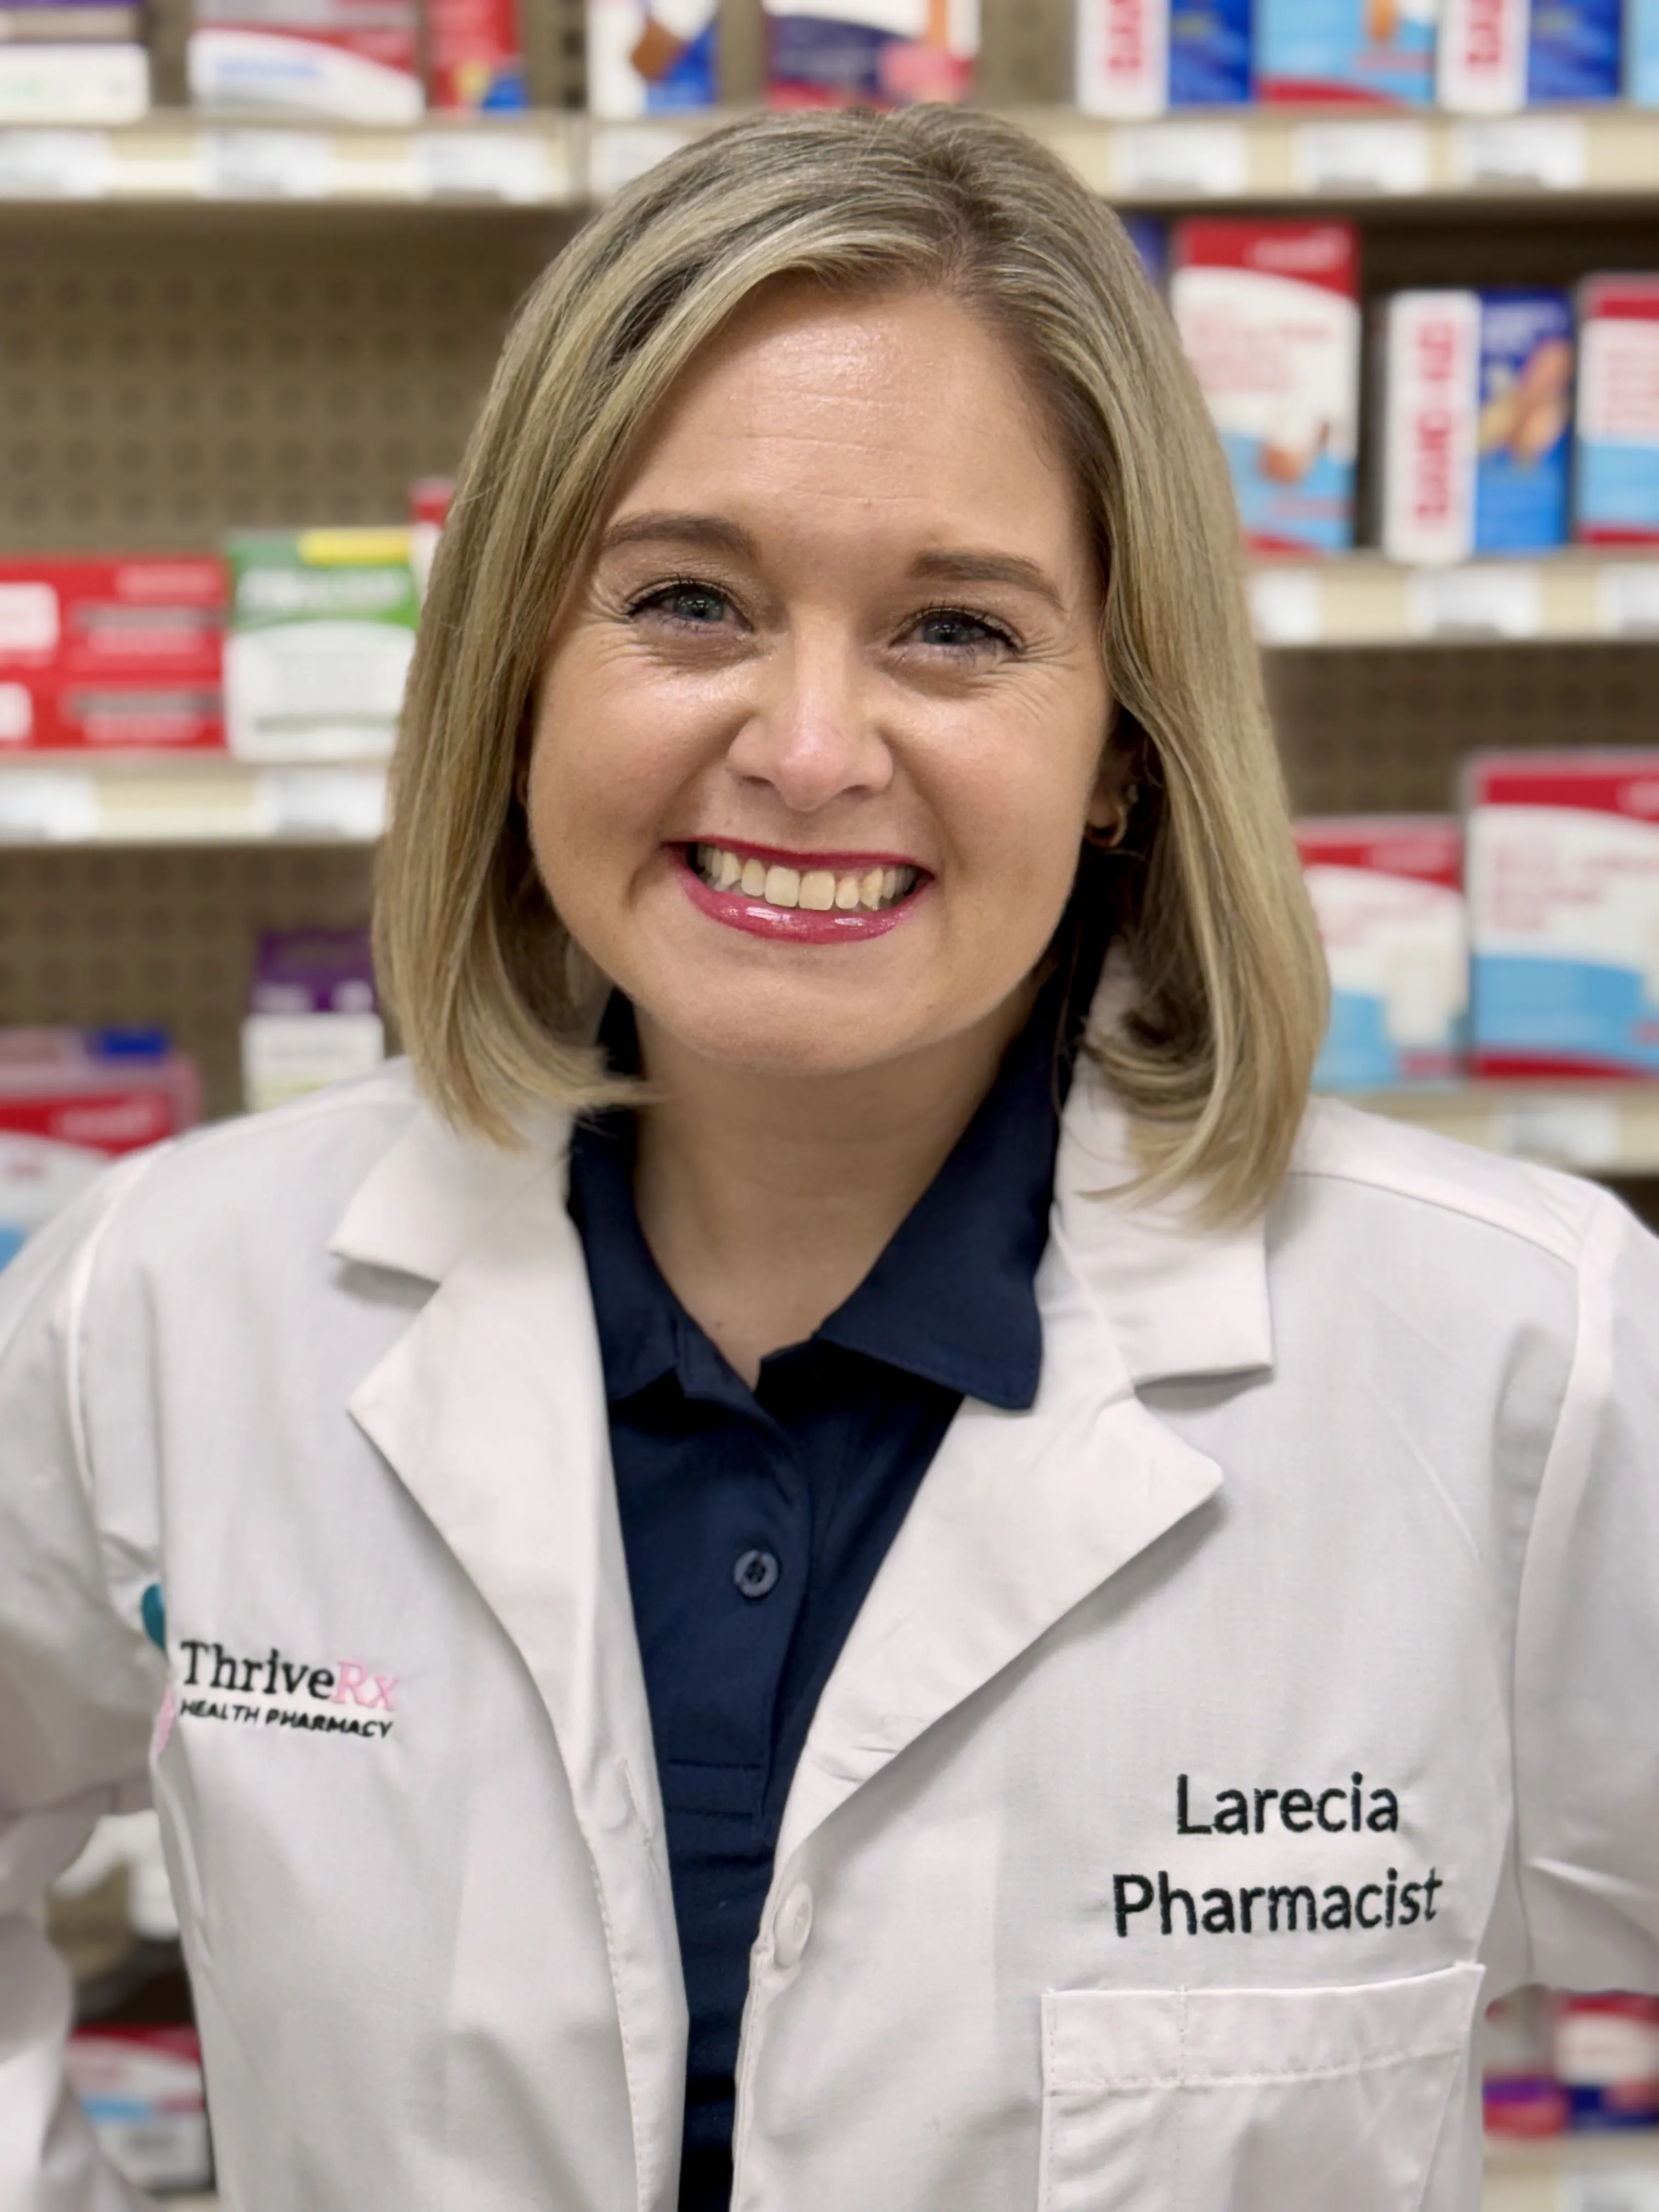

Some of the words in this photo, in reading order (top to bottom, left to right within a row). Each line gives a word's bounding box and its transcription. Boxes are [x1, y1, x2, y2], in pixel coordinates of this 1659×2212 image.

[180, 1640, 400, 1711] ThriveRx
[180, 1699, 259, 1723] HEALTH
[266, 1708, 393, 1738] PHARMACY
[1176, 1771, 1398, 1835] Larecia
[1113, 1866, 1443, 1938] Pharmacist
